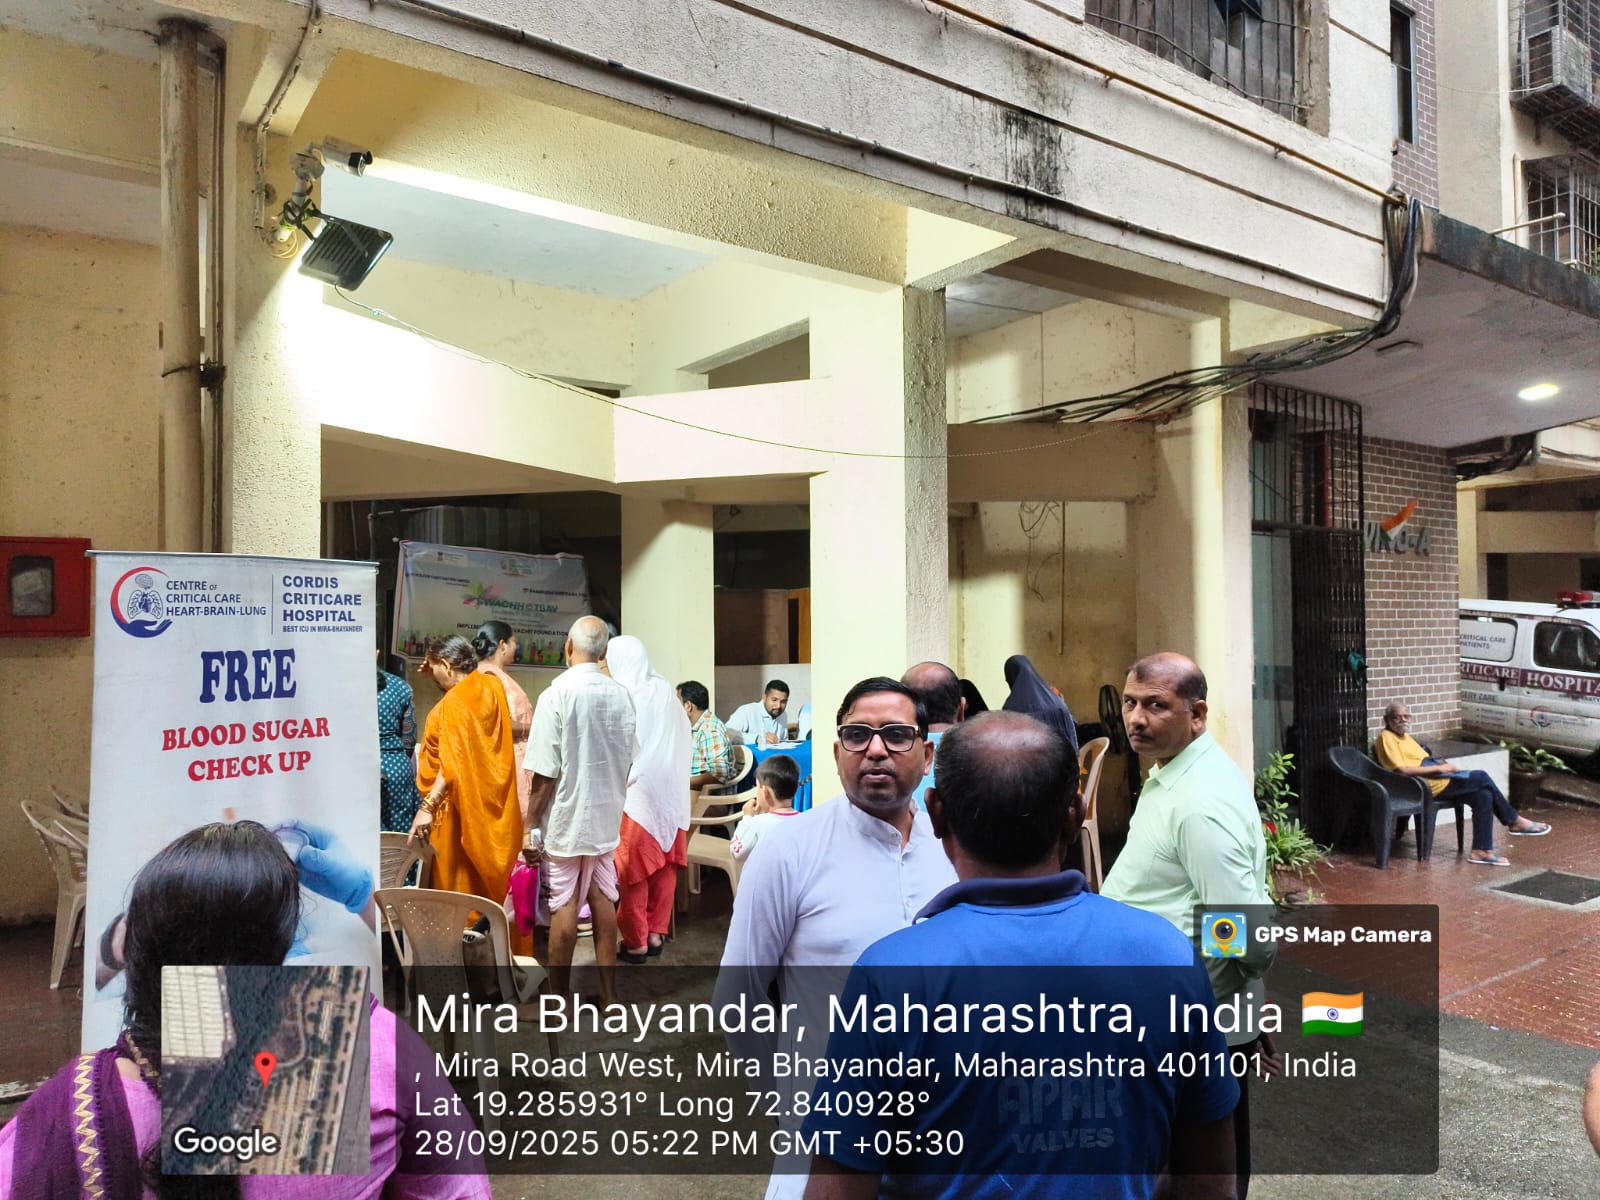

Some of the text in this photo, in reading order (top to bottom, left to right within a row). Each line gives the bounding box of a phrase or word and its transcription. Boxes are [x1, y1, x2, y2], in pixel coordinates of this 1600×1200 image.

[166, 580, 207, 591] CENTRE
[282, 575, 339, 589] CORDIS
[166, 593, 242, 604] CRITICAL CARE
[282, 592, 362, 606] CRITICARE
[166, 606, 267, 617] HEART-BRAIN-LUNG
[282, 609, 356, 622] HOSPITAL
[282, 625, 363, 633] BEST ICU IN MIRA-BHAYANDER
[199, 648, 297, 703] FREE
[1459, 662, 1519, 680] RITICARE
[162, 717, 330, 751] BLOOD SUGAR
[187, 750, 312, 782] CHECK UP
[1012, 1127, 1115, 1154] VALVES
